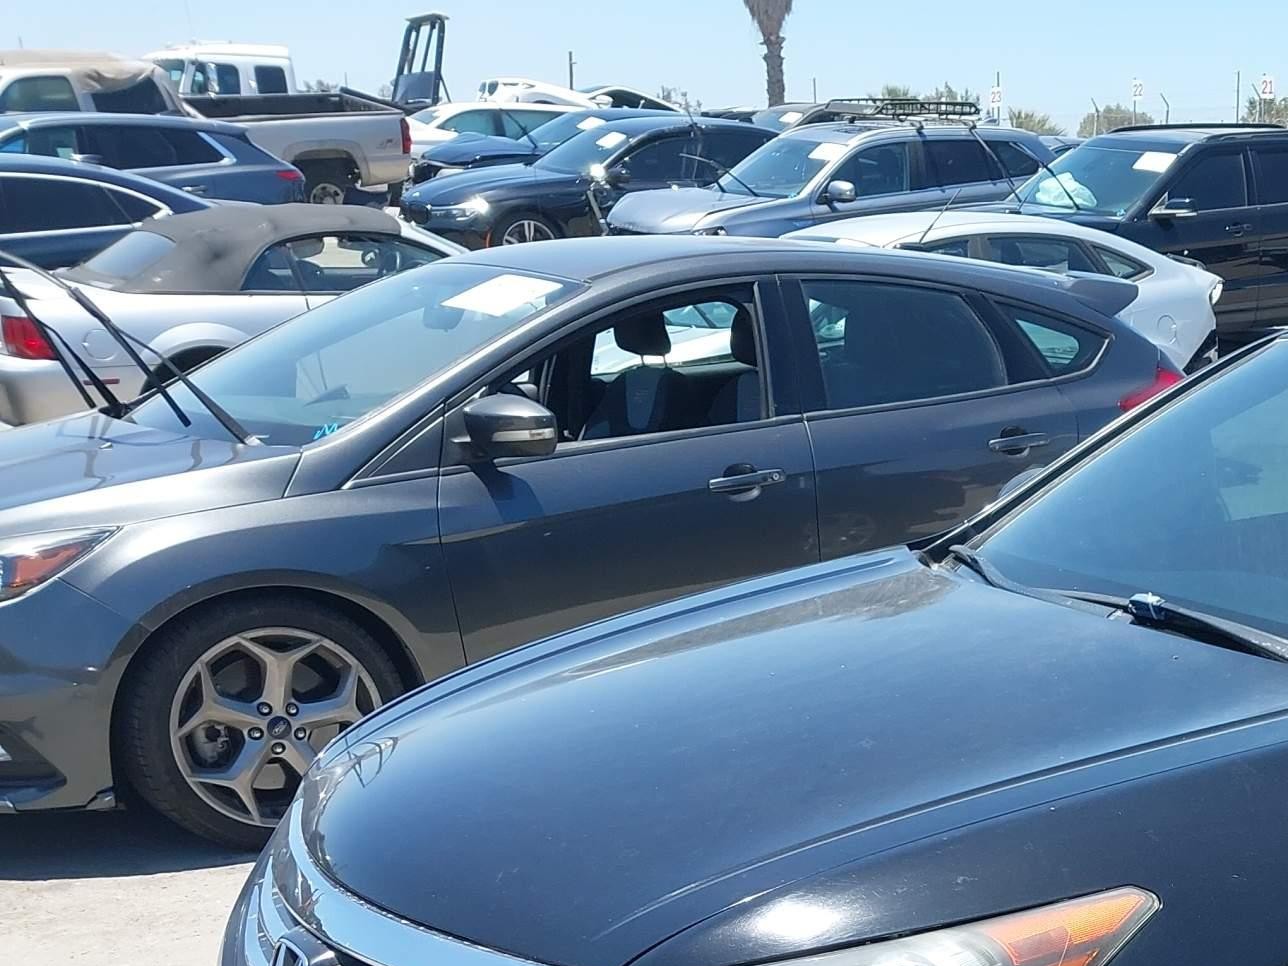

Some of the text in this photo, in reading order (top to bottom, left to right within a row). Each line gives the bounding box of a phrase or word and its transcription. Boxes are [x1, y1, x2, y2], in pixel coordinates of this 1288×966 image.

[1133, 82, 1144, 97] 22
[1261, 80, 1274, 95] 21
[991, 90, 1002, 104] 23
